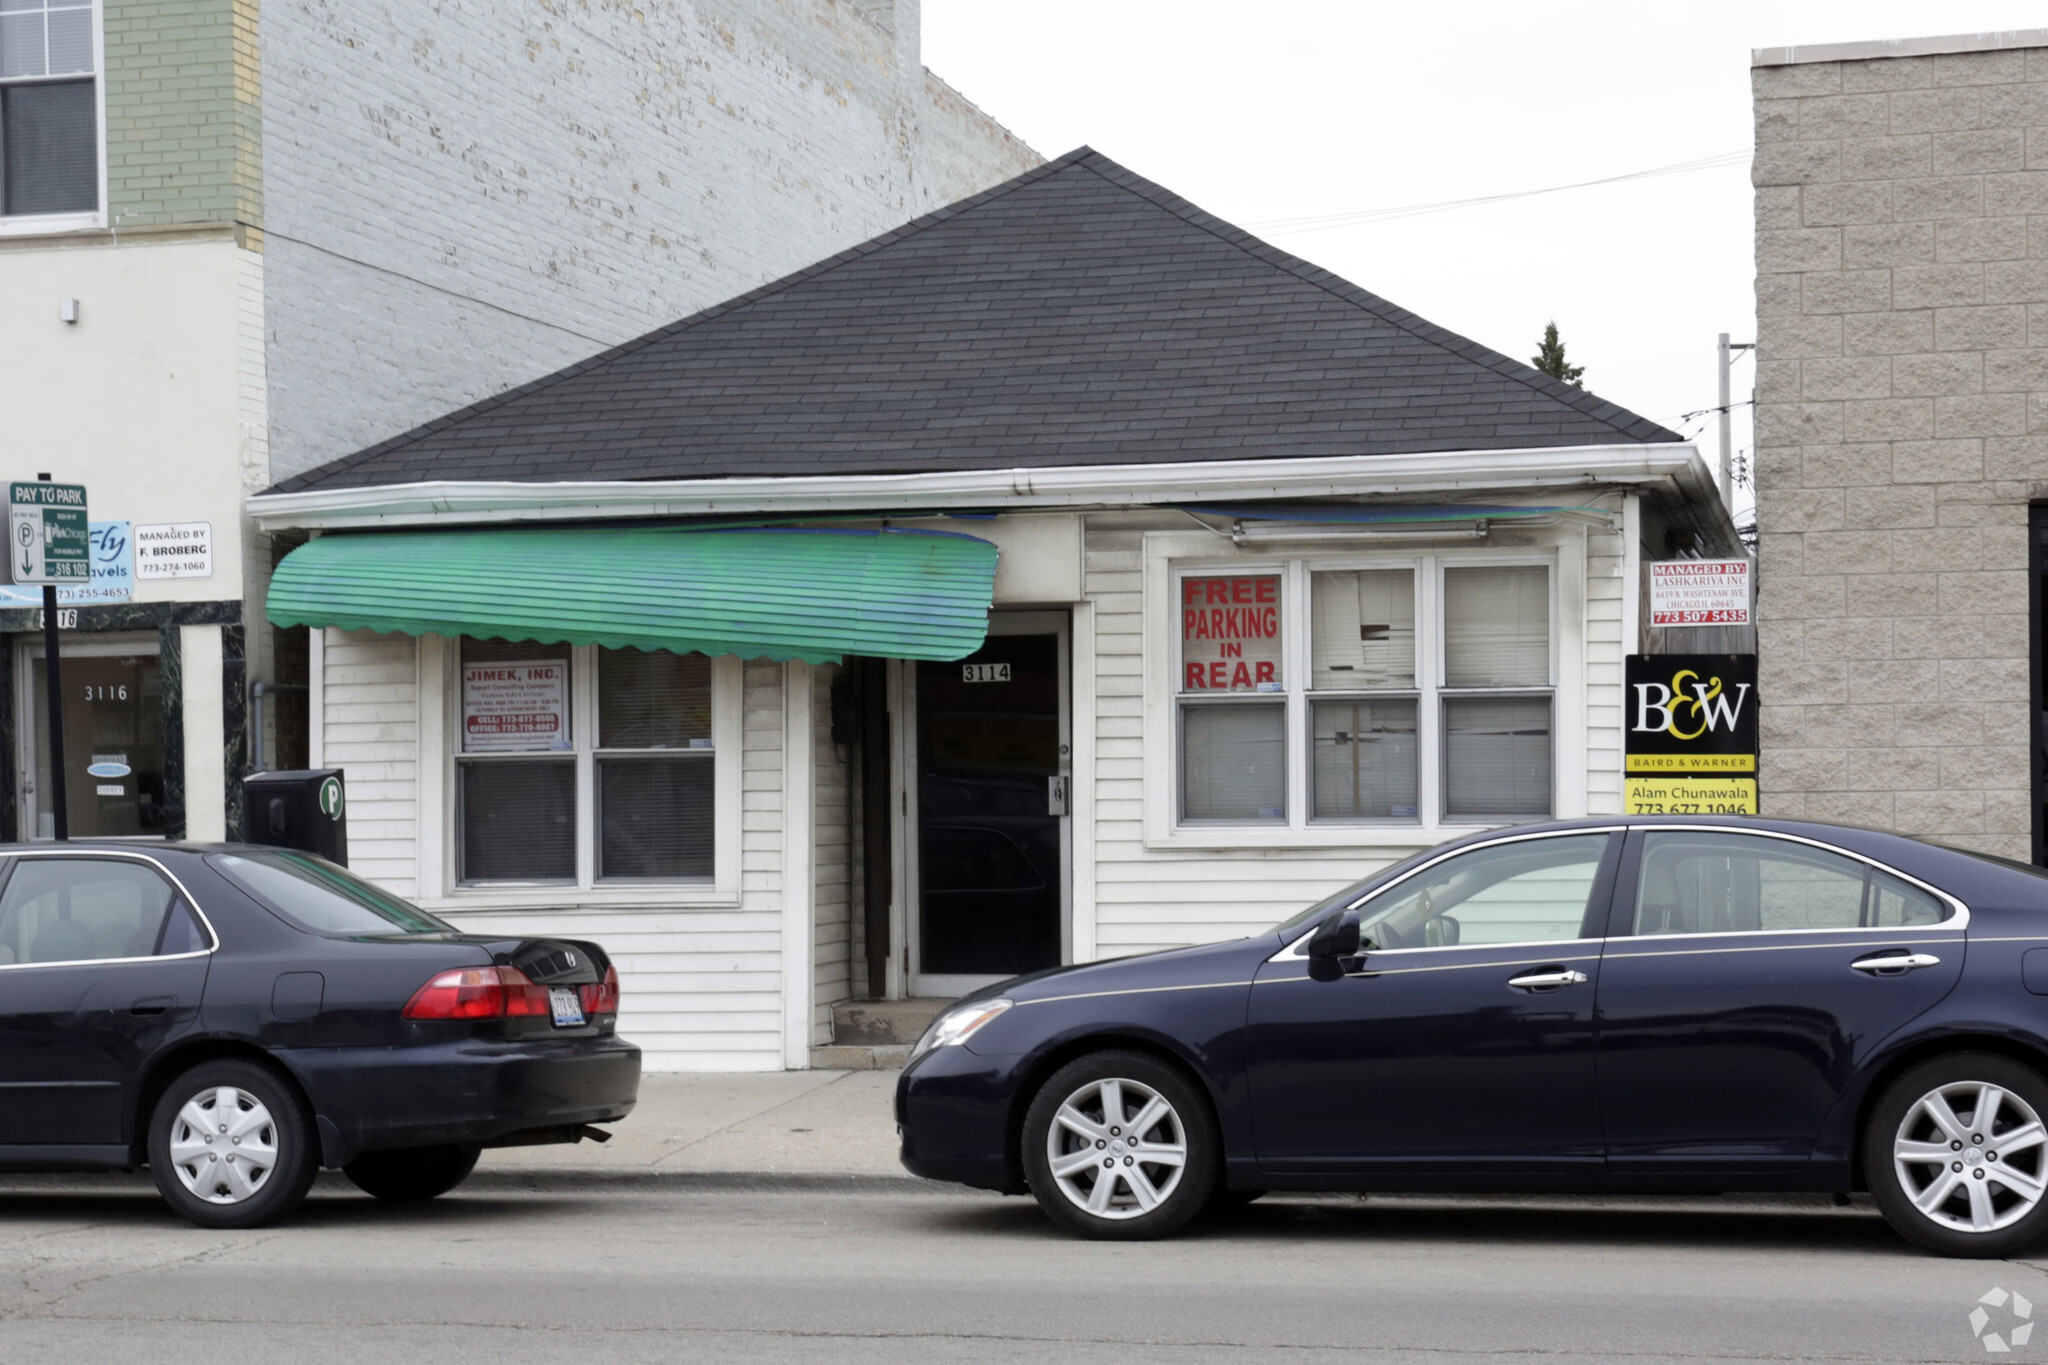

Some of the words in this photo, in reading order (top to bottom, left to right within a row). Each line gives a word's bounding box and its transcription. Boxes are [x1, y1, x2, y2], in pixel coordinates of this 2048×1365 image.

[15, 487, 37, 502] PAY
[39, 488, 55, 503] TO
[56, 489, 82, 505] PARK
[22, 528, 31, 543] P
[140, 530, 190, 541] MANAGED
[193, 530, 205, 538] BY
[152, 545, 207, 556] BROBERG
[55, 562, 72, 576] 516
[72, 563, 87, 576] 102
[91, 566, 127, 578] avels
[143, 562, 205, 573] 773-274-1060
[1655, 565, 1721, 575] MANAGED
[1725, 564, 1746, 574] BY:
[1656, 577, 1724, 587] LASHKARIYA
[1727, 576, 1745, 585] INC
[79, 588, 130, 599] 255-4653
[1184, 579, 1276, 605] FREE
[1683, 589, 1729, 598] WASHTENAW
[1710, 600, 1735, 608] 60645
[1655, 611, 1680, 622] 773
[1683, 611, 1709, 621] 507
[1712, 610, 1746, 621] 5435
[1185, 606, 1277, 640] PARKING
[1220, 642, 1242, 657] IN
[466, 670, 522, 682] JIMEK,
[527, 668, 559, 680] INC.
[964, 665, 1009, 681] 3114
[1186, 661, 1275, 688] REAR
[85, 685, 127, 700] 3116
[1631, 669, 1750, 740] B&W
[469, 725, 499, 733] OFFICE:
[328, 784, 338, 813] P
[1632, 788, 1667, 798] Alam
[1671, 788, 1748, 799] Chunawala
[1634, 804, 1663, 814] 773
[1670, 804, 1699, 814] 677
[1707, 804, 1746, 814] 1046
